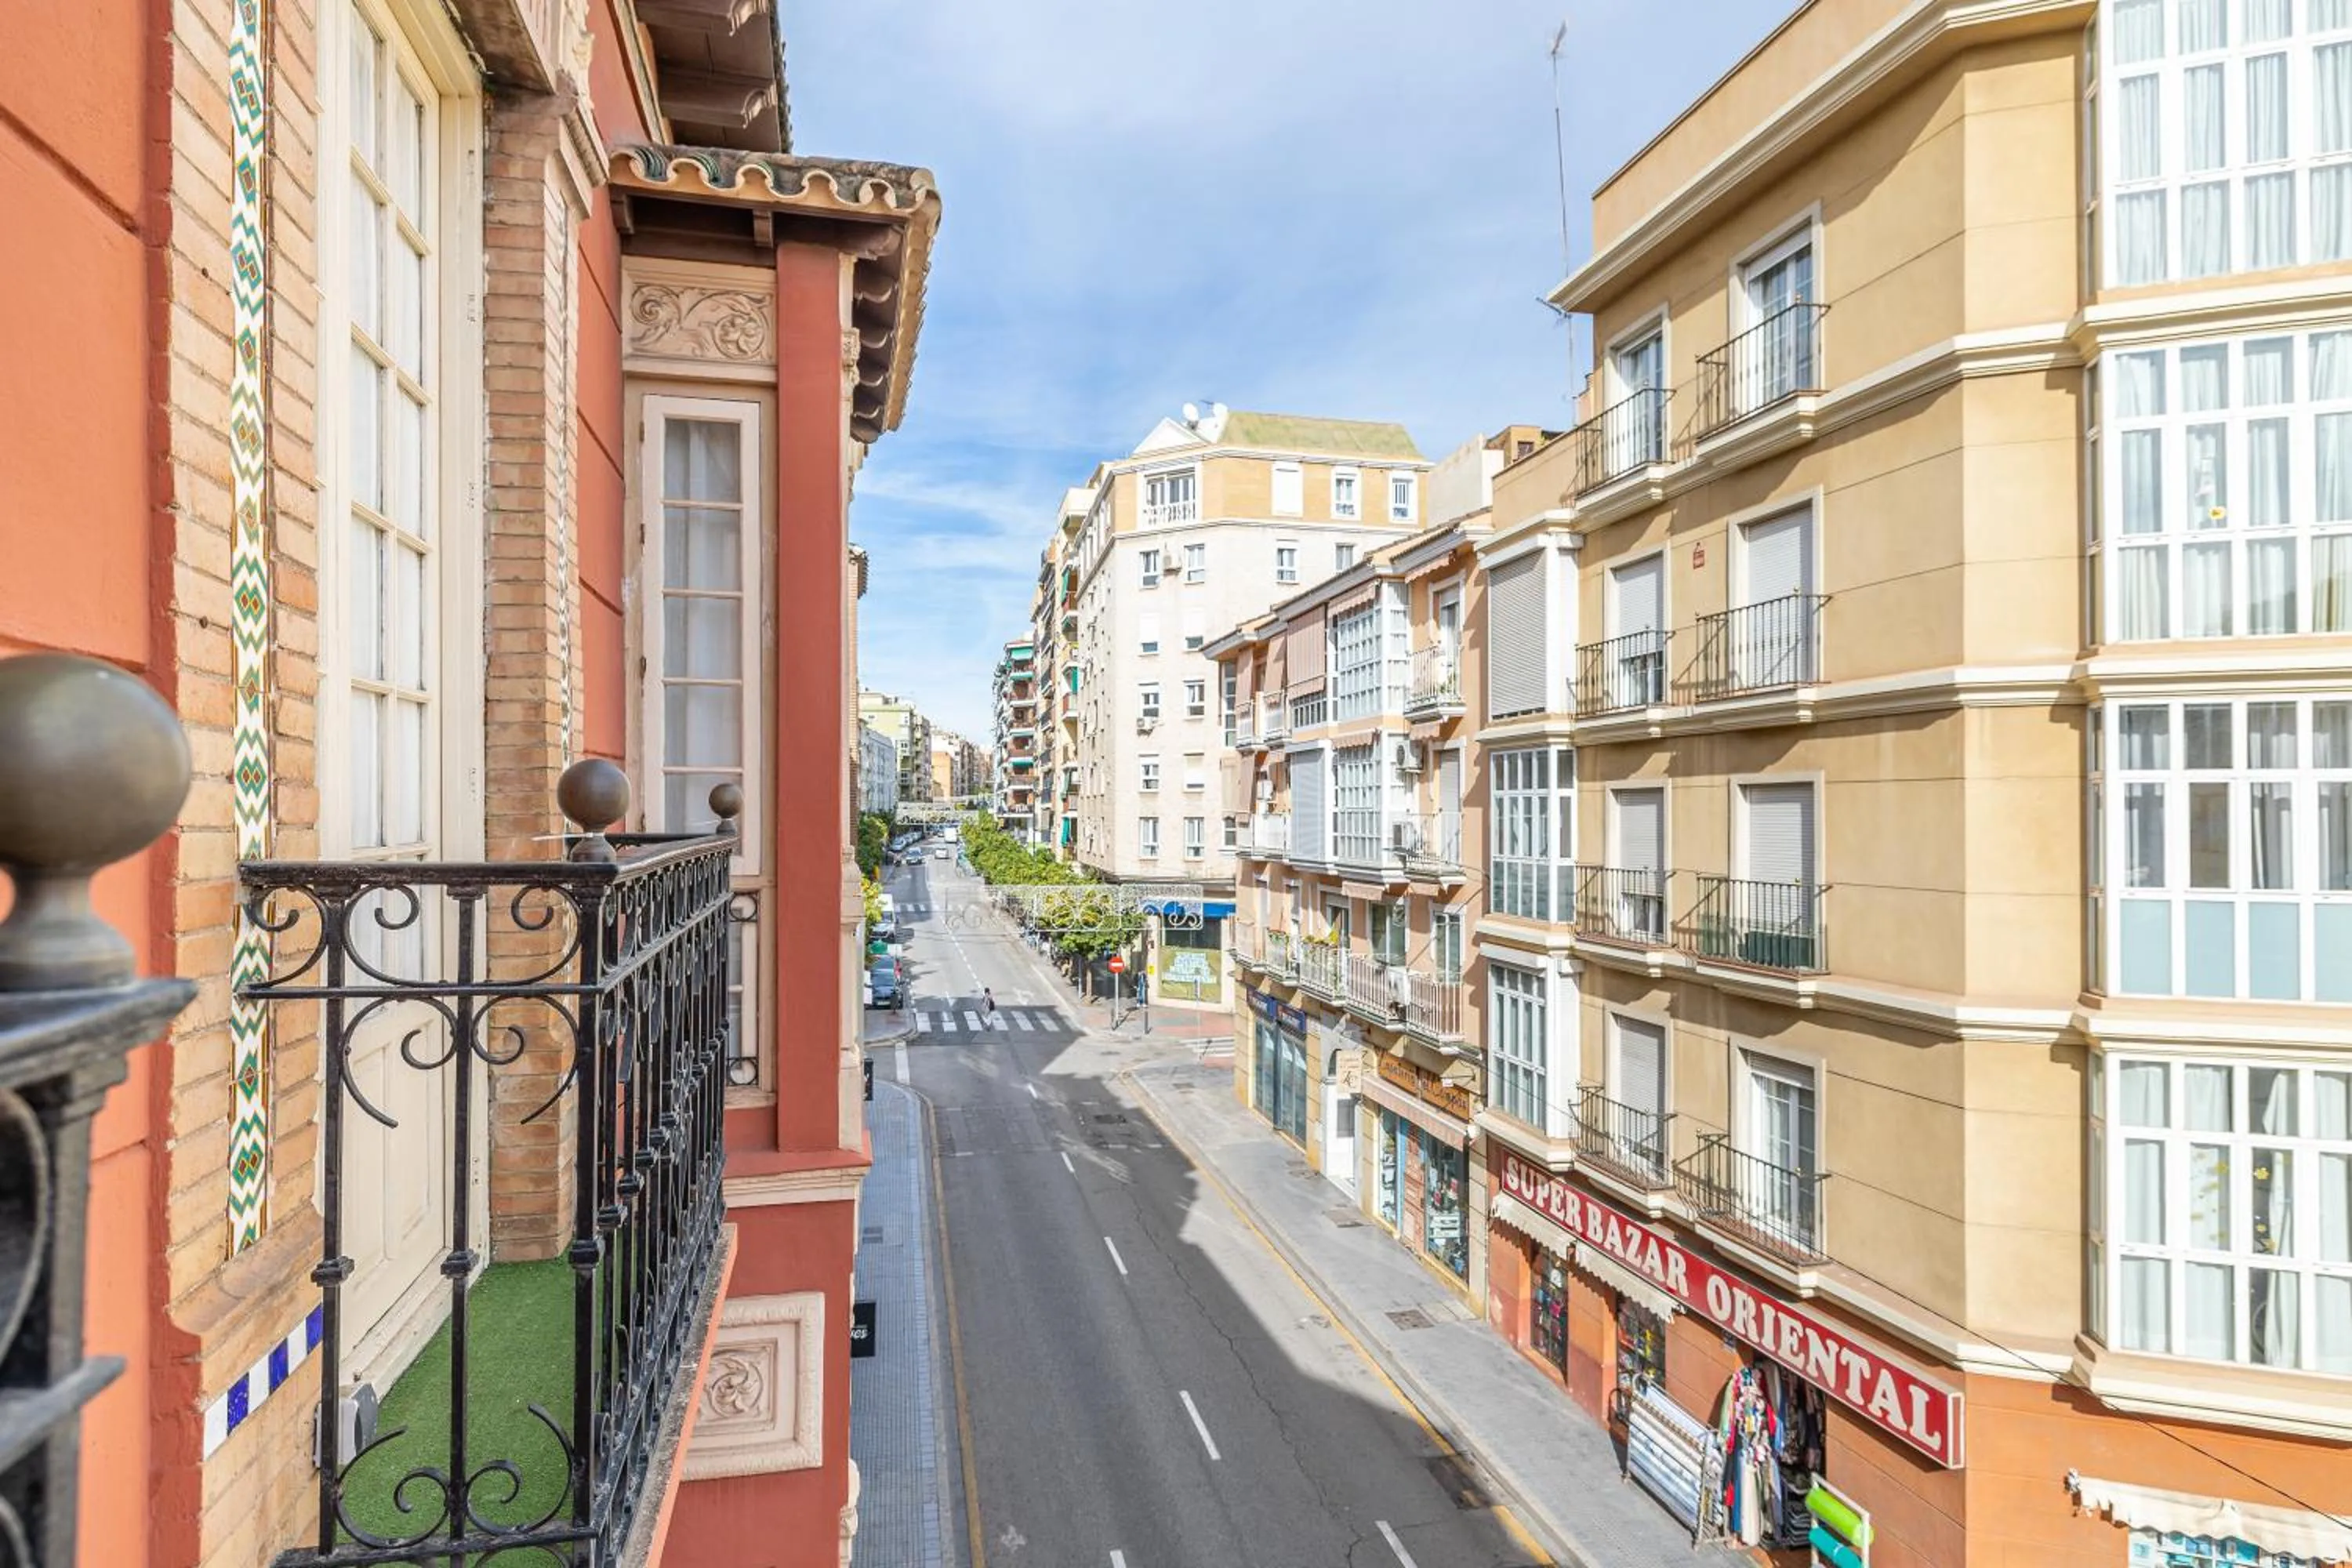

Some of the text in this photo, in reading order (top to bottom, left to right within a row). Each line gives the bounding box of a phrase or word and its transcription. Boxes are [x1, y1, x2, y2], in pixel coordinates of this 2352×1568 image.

[1506, 1156, 1942, 1451] SUPER BAZAR ORIENTAL
